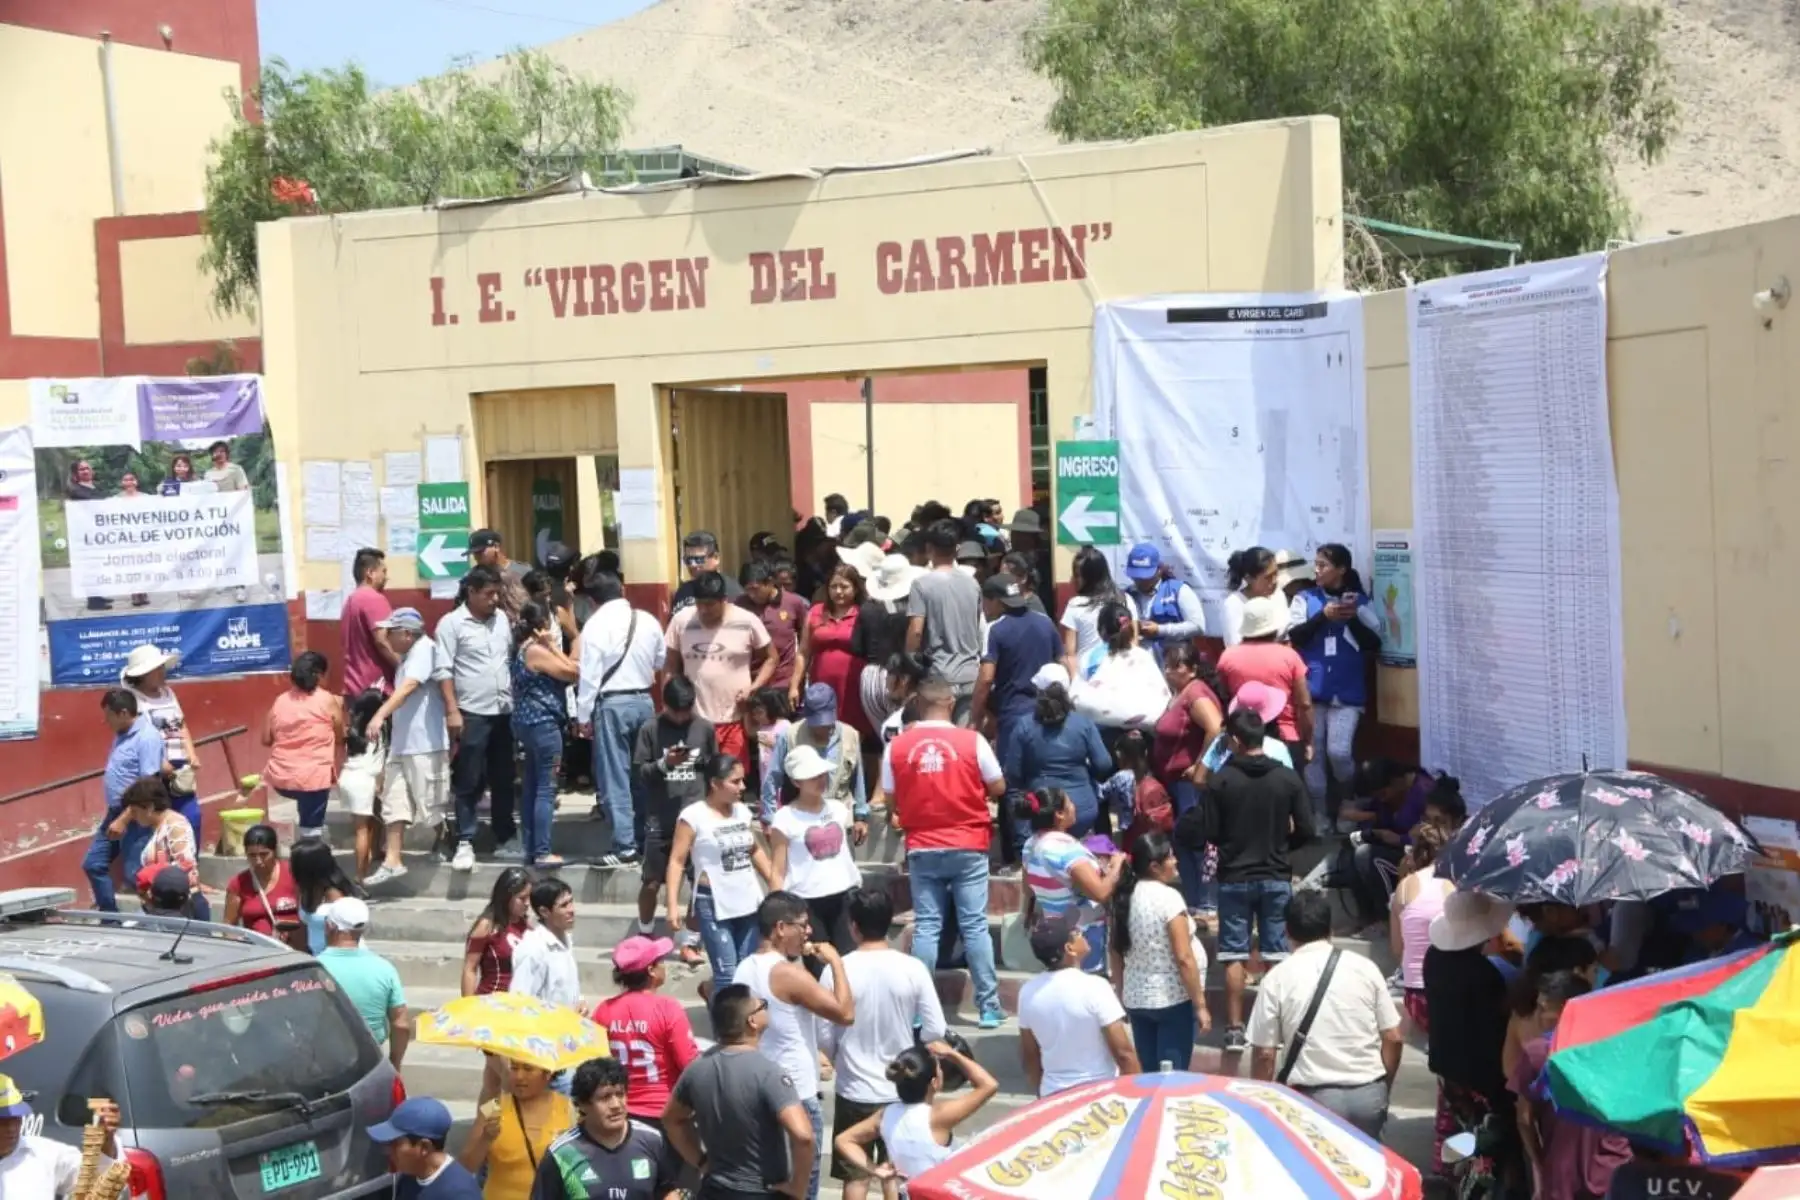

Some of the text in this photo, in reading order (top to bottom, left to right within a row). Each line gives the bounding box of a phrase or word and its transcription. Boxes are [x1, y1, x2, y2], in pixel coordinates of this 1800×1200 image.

[430, 277, 459, 326] I.
[477, 272, 517, 323] E.
[750, 247, 836, 305] DEL
[1058, 456, 1118, 478] INGRESO
[95, 506, 228, 527] BIENVENIDO A TU
[422, 498, 468, 515] SALIDA
[84, 522, 241, 546] LOCAL DE VOTACIÓN
[103, 546, 226, 567] Jornada electoral
[217, 633, 261, 649] ONPE
[153, 979, 323, 1028] Vida que cuida tu Vida
[610, 1019, 649, 1034] ALAYO
